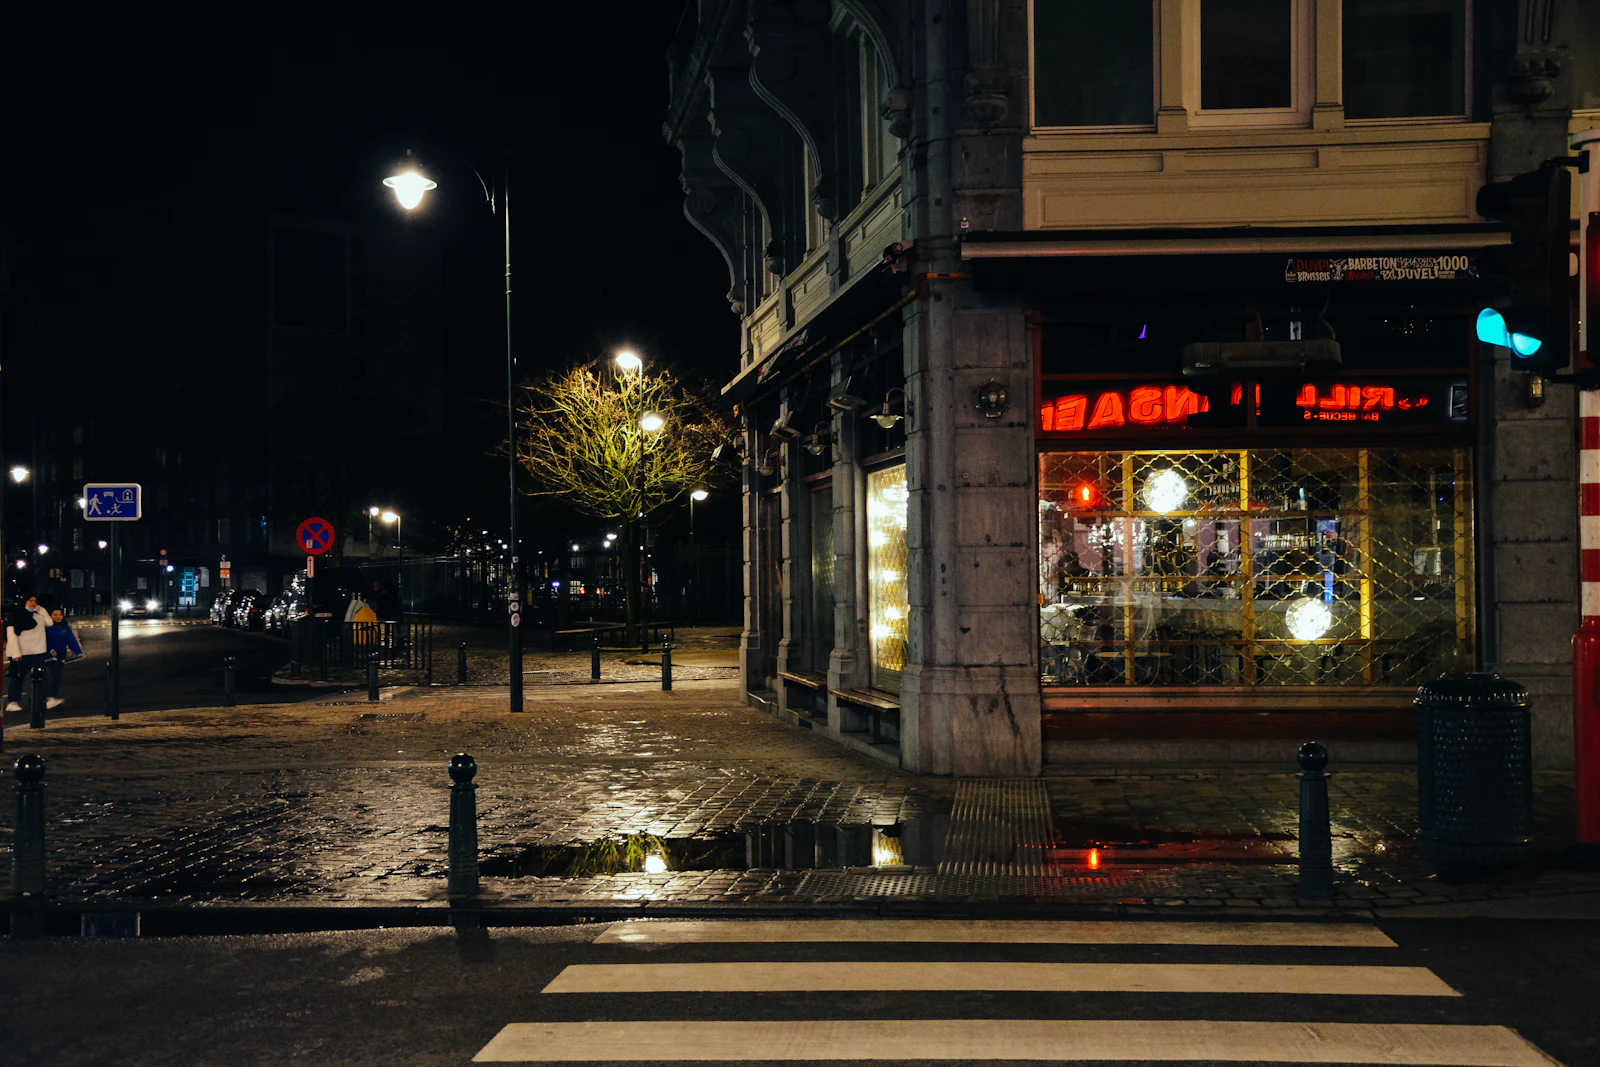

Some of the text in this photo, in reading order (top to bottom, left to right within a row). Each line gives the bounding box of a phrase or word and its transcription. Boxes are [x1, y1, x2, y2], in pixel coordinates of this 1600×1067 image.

[1347, 257, 1397, 271] BARBETON
[1437, 255, 1469, 271] 1000
[1396, 267, 1435, 280] DUVEL
